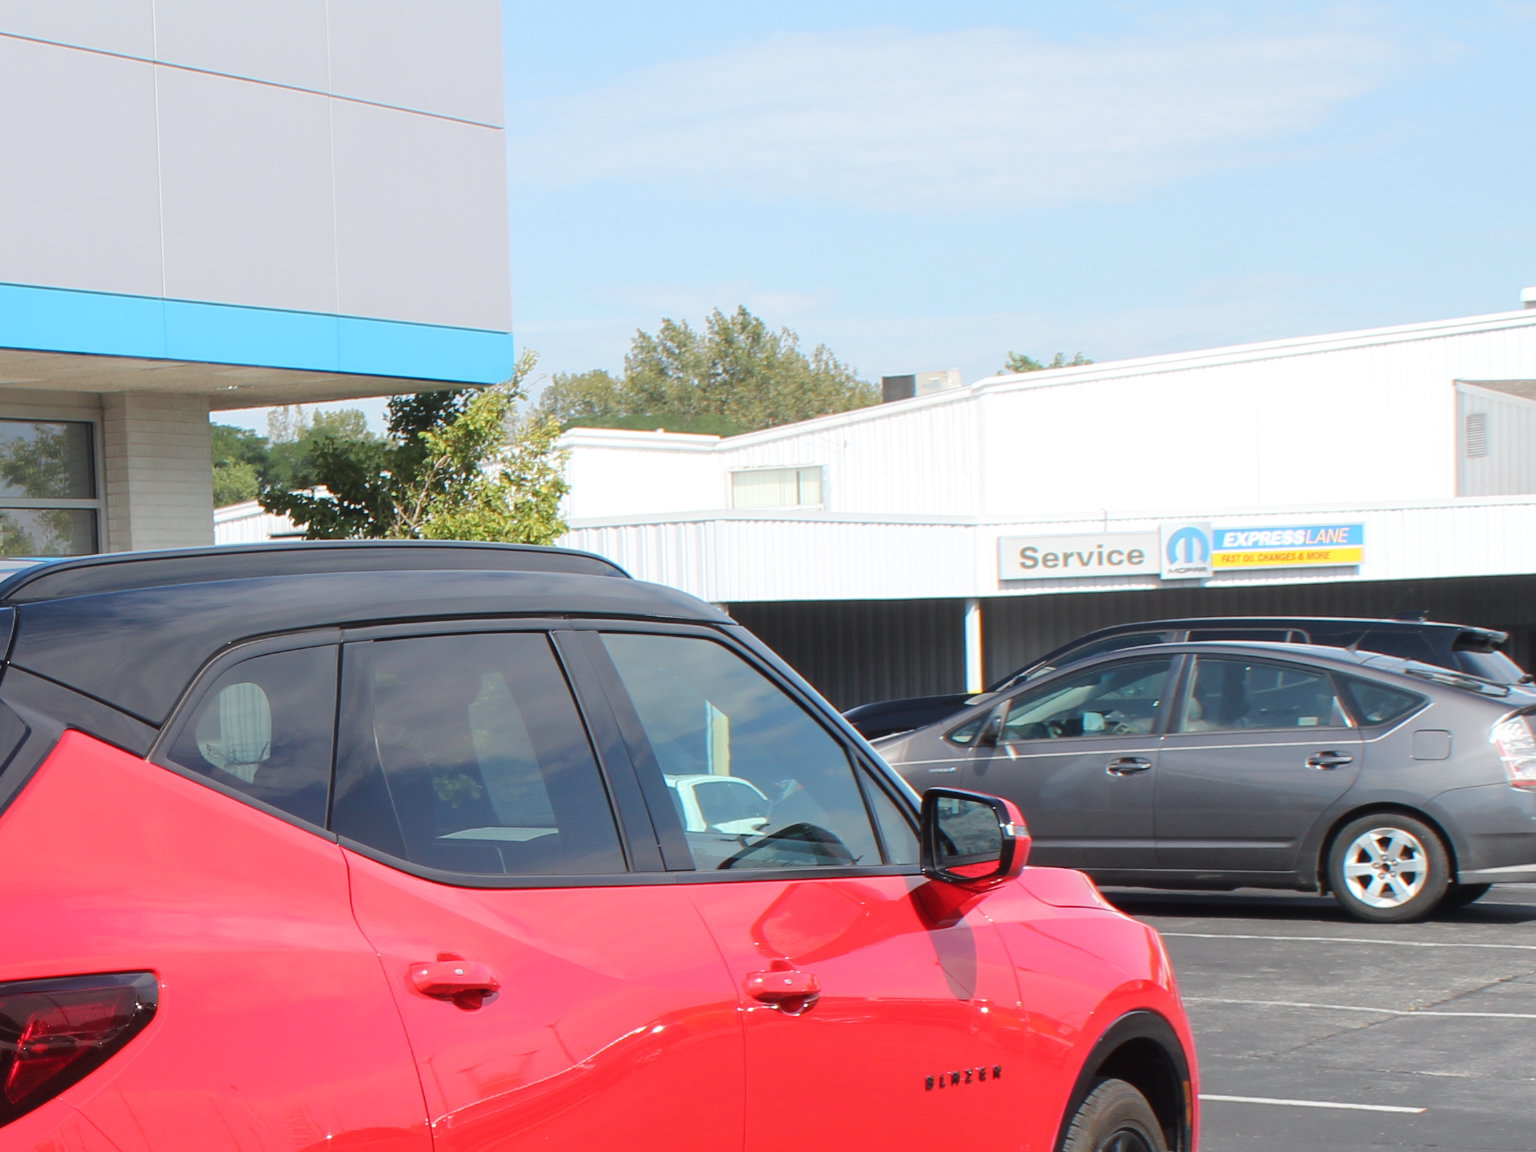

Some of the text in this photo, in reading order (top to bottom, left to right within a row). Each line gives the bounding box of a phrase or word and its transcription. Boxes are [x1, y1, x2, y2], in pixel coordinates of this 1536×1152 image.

[1223, 527, 1350, 547] EXPRESSLANE
[1019, 544, 1145, 569] Service
[1221, 551, 1331, 563] FAST OIL CHANGES & MORE
[925, 1065, 1001, 1091] BLAZER
